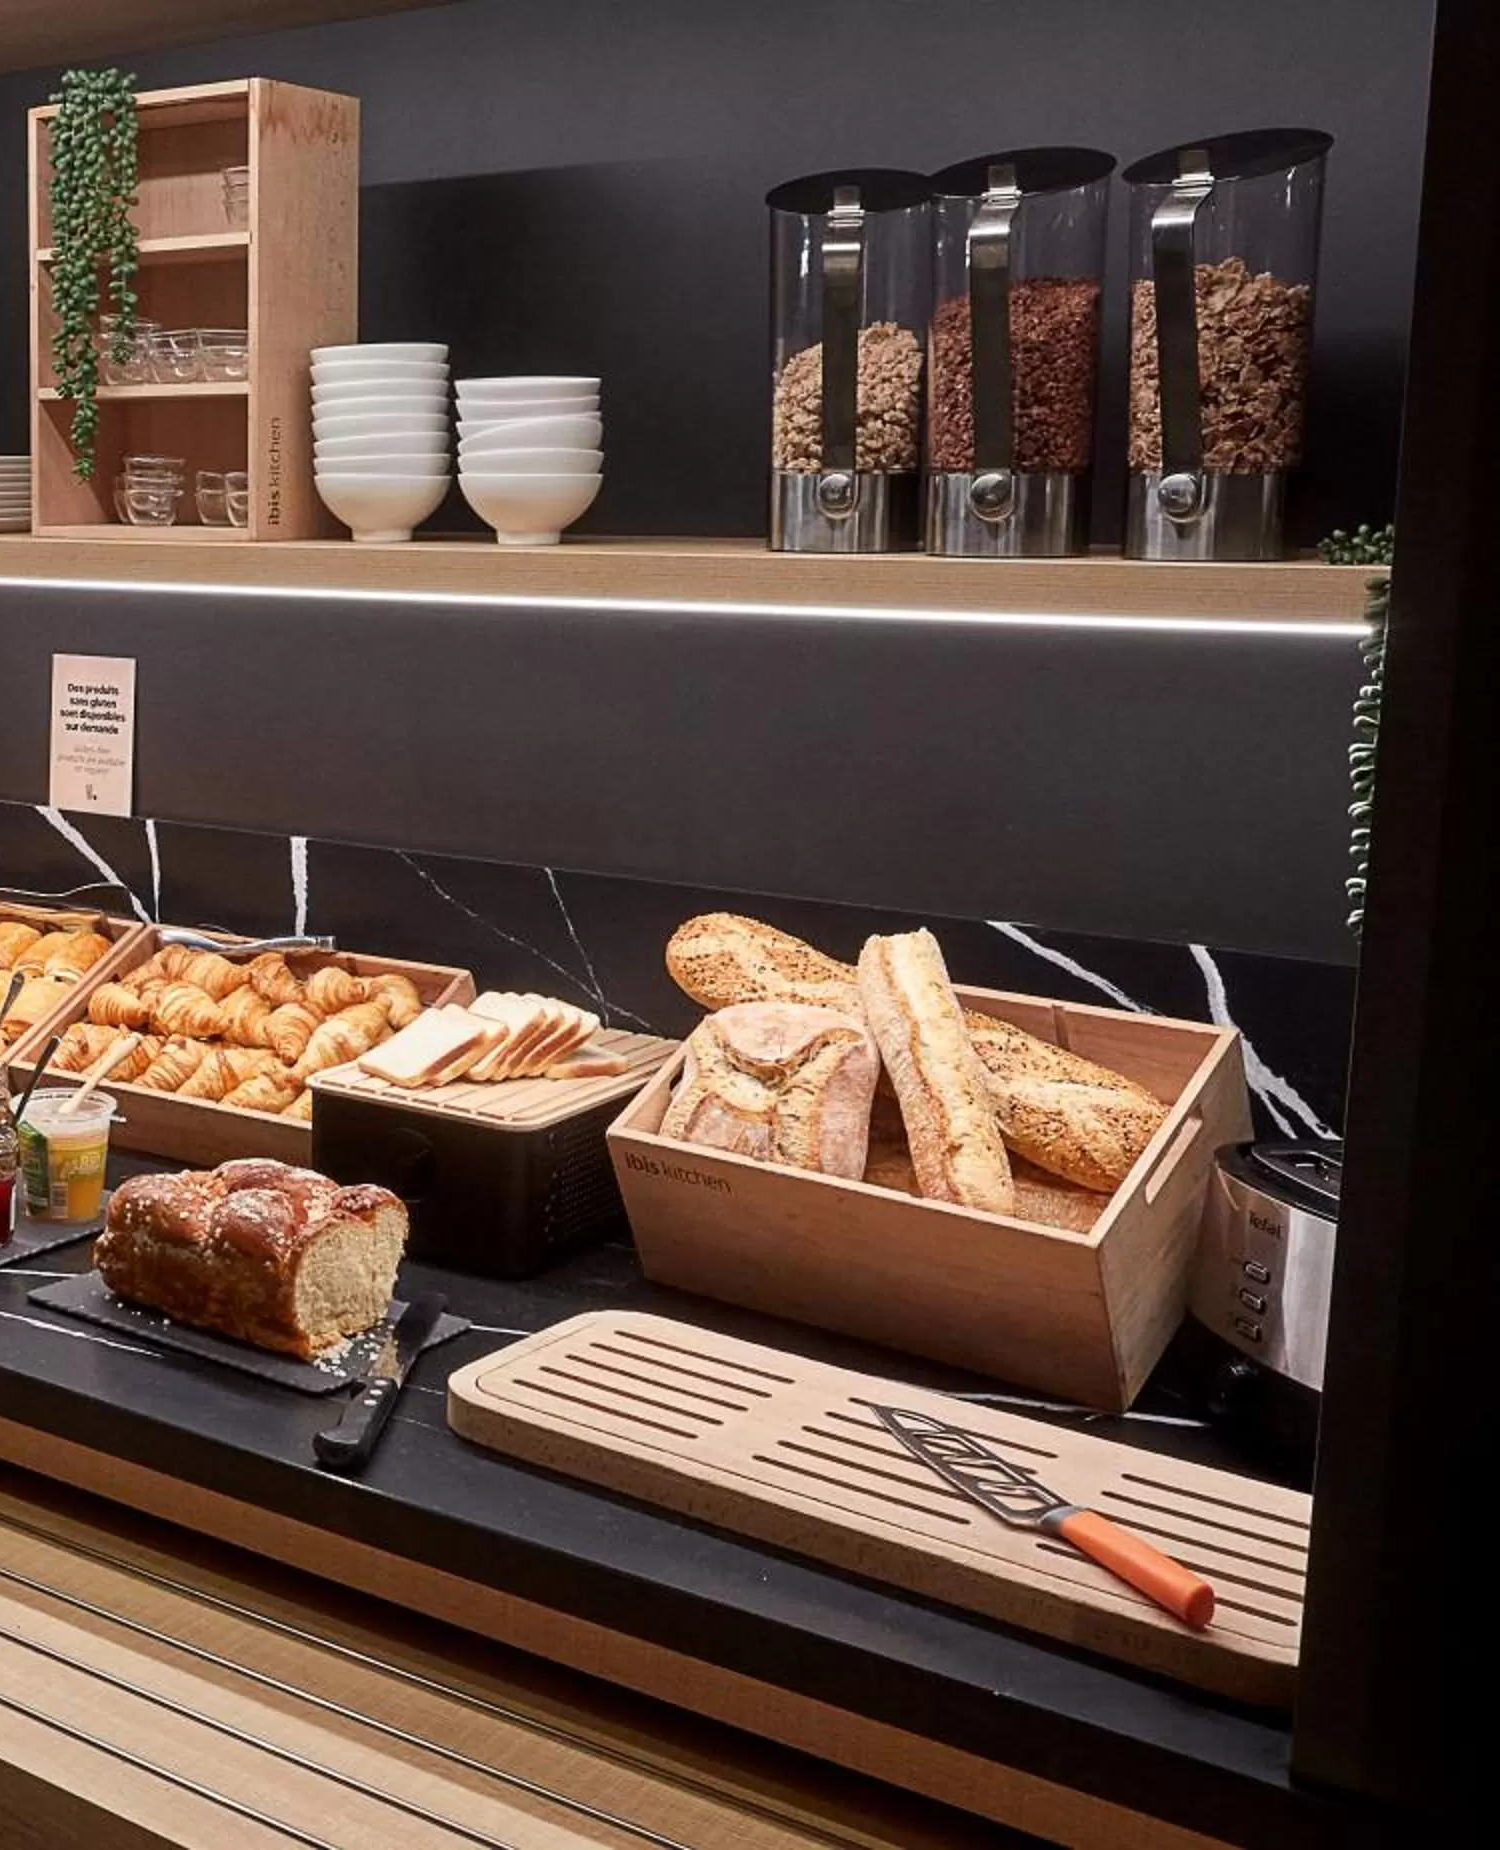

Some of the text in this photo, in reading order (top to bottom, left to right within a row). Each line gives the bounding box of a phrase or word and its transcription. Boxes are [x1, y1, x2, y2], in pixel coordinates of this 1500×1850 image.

[267, 416, 281, 525] ibis kitchen
[67, 683, 119, 696] Des produits
[69, 697, 117, 708] sans gluten
[60, 709, 126, 722] sont disponibles
[65, 721, 119, 735] sur demande
[624, 1151, 734, 1194] ibis kitchen
[1249, 1210, 1281, 1240] Tefal
